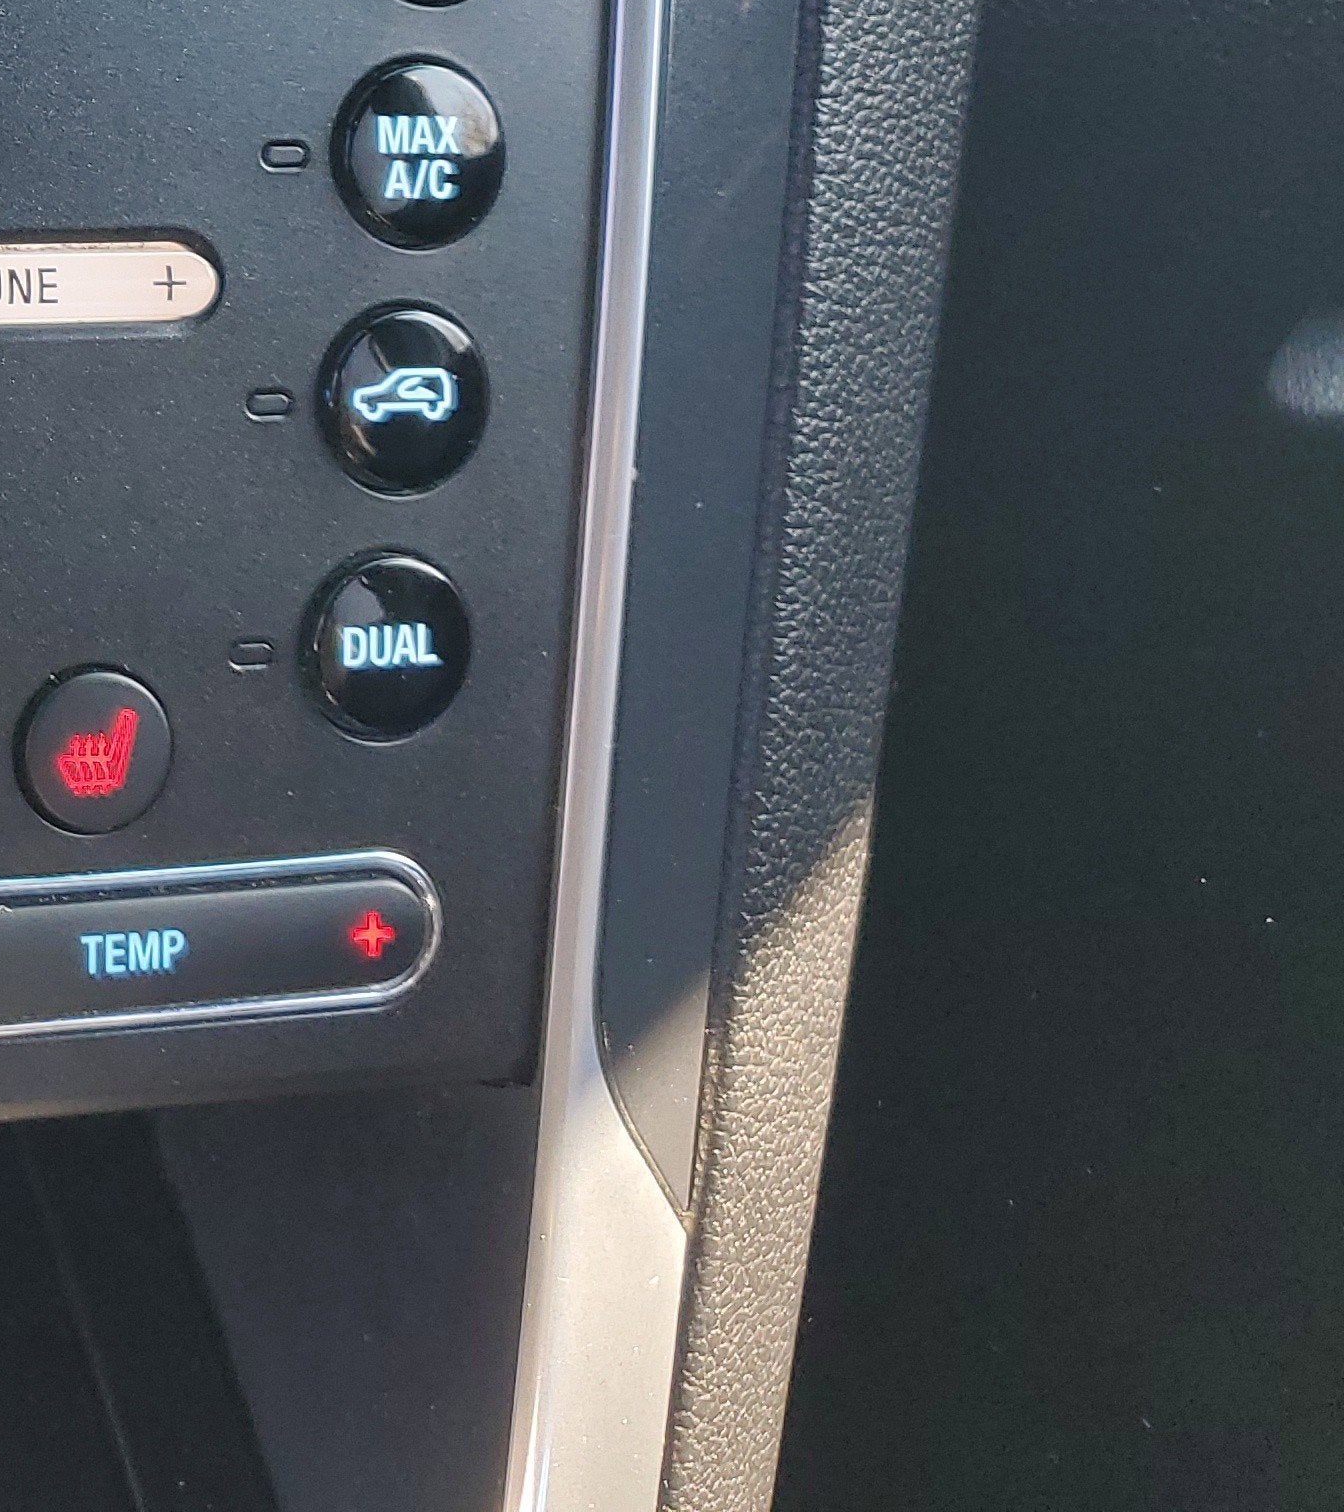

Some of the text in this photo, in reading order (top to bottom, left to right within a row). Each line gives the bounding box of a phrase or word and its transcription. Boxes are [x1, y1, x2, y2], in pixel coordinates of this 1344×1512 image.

[377, 116, 458, 154] MAX
[384, 160, 458, 200] A/C
[342, 624, 438, 668] DUAL
[81, 931, 186, 973] TEMP
